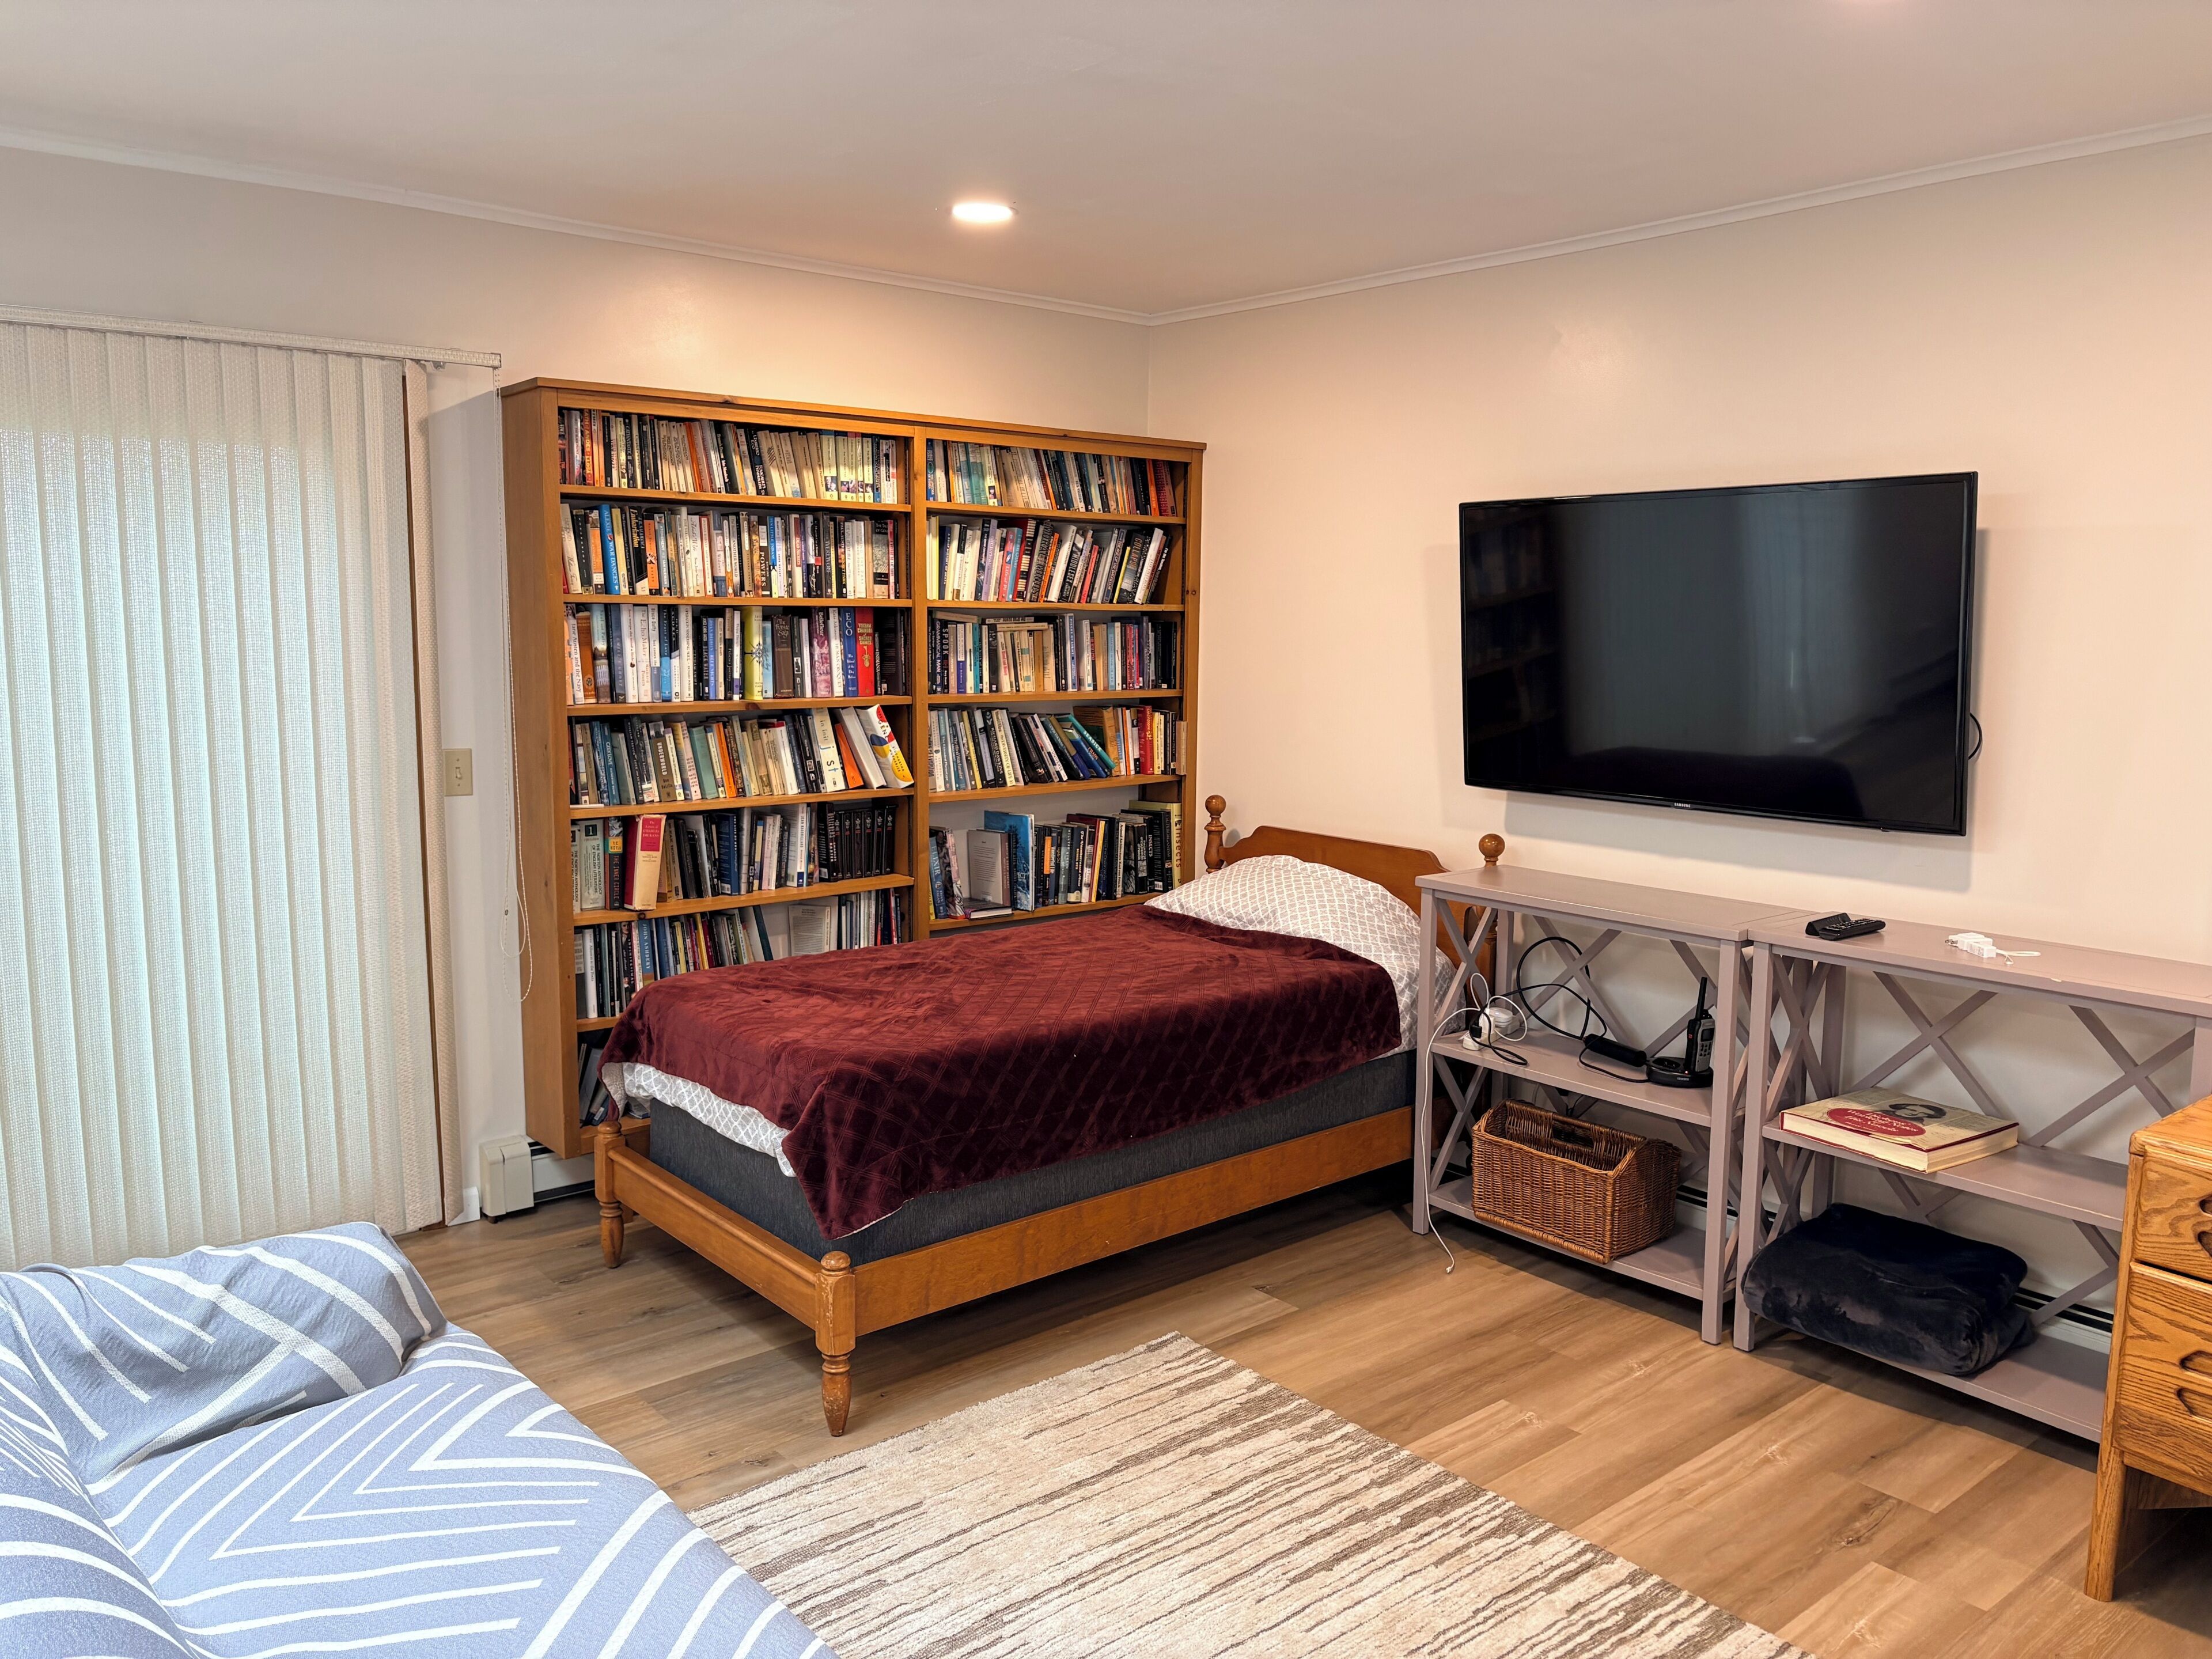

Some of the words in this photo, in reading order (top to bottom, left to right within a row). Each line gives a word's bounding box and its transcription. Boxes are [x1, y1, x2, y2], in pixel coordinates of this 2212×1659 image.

[1066, 554, 1080, 584] MIDDLESEX
[1084, 731, 1101, 752] SEASICK
[657, 743, 667, 775] UNDERWORLD
[931, 846, 941, 876] ELIXIR
